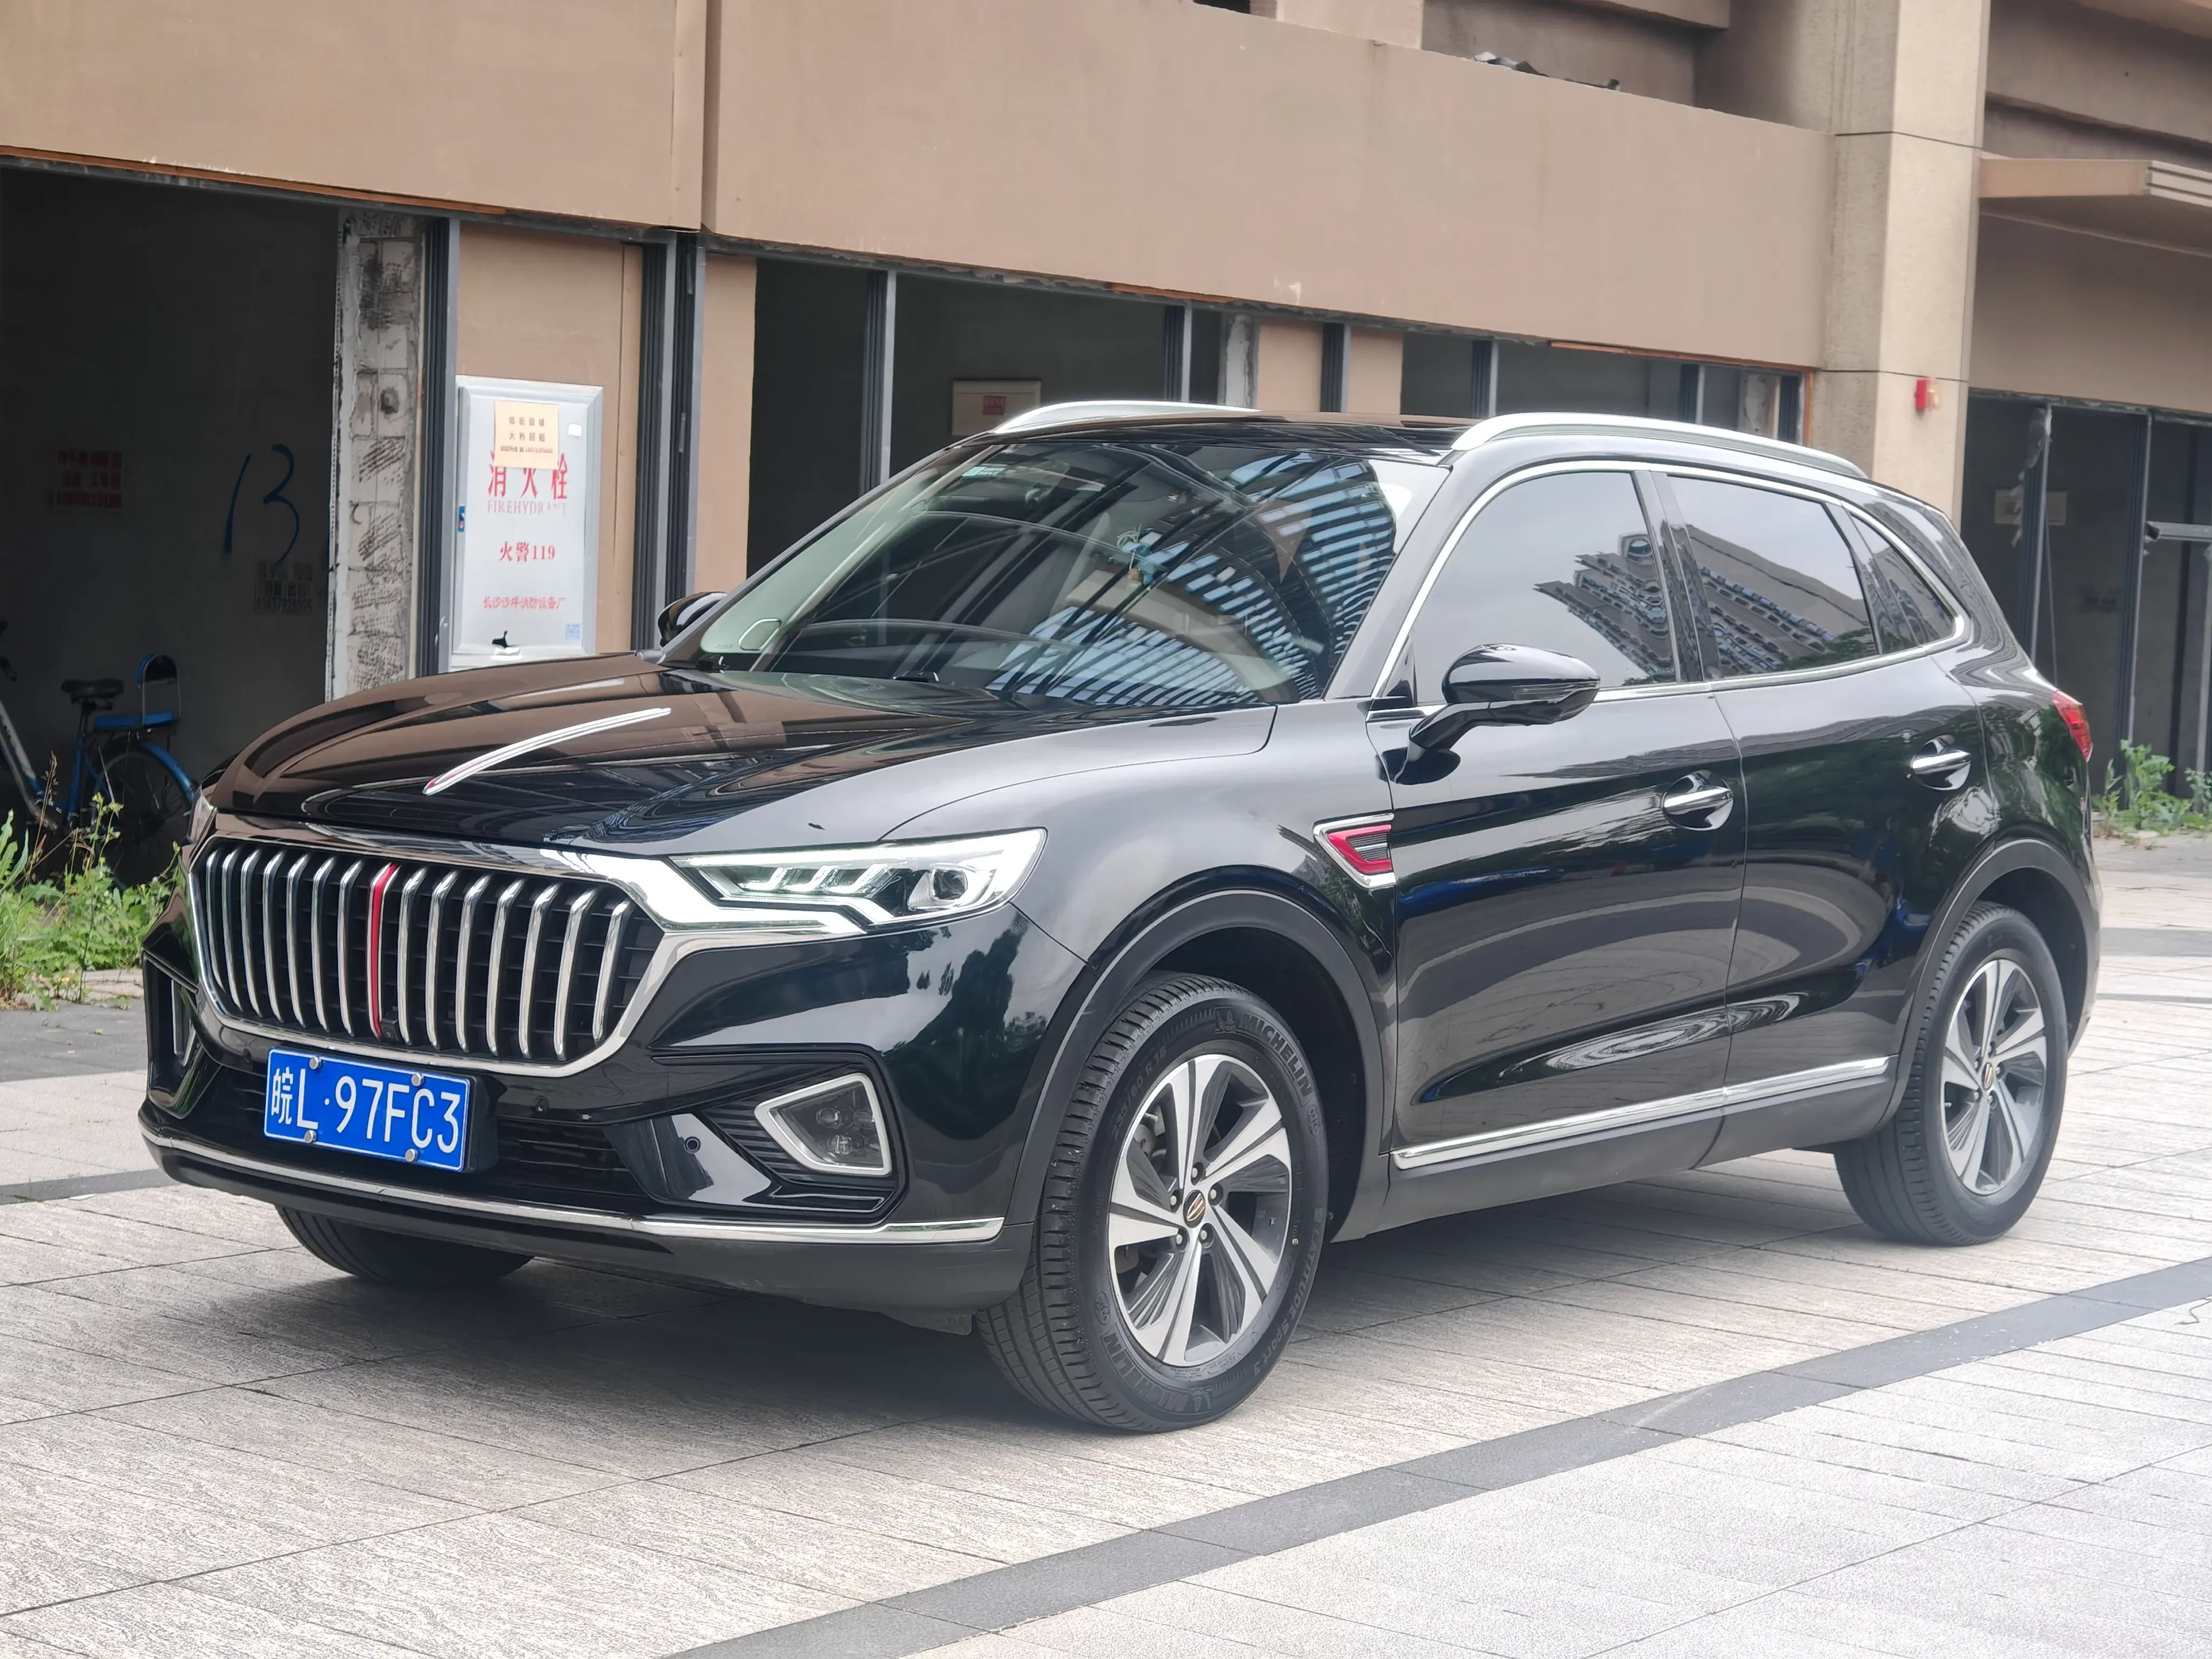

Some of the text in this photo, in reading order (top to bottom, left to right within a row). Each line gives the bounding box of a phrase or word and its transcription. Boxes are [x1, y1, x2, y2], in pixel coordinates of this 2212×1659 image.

[222, 444, 299, 570] 13
[488, 449, 568, 500] 消火栓
[499, 541, 556, 562] 火警119
[1239, 1012, 1313, 1098] MICHELIN
[271, 1066, 461, 1154] 皖L·97FC3
[1102, 1332, 1191, 1412] MICHELIN
